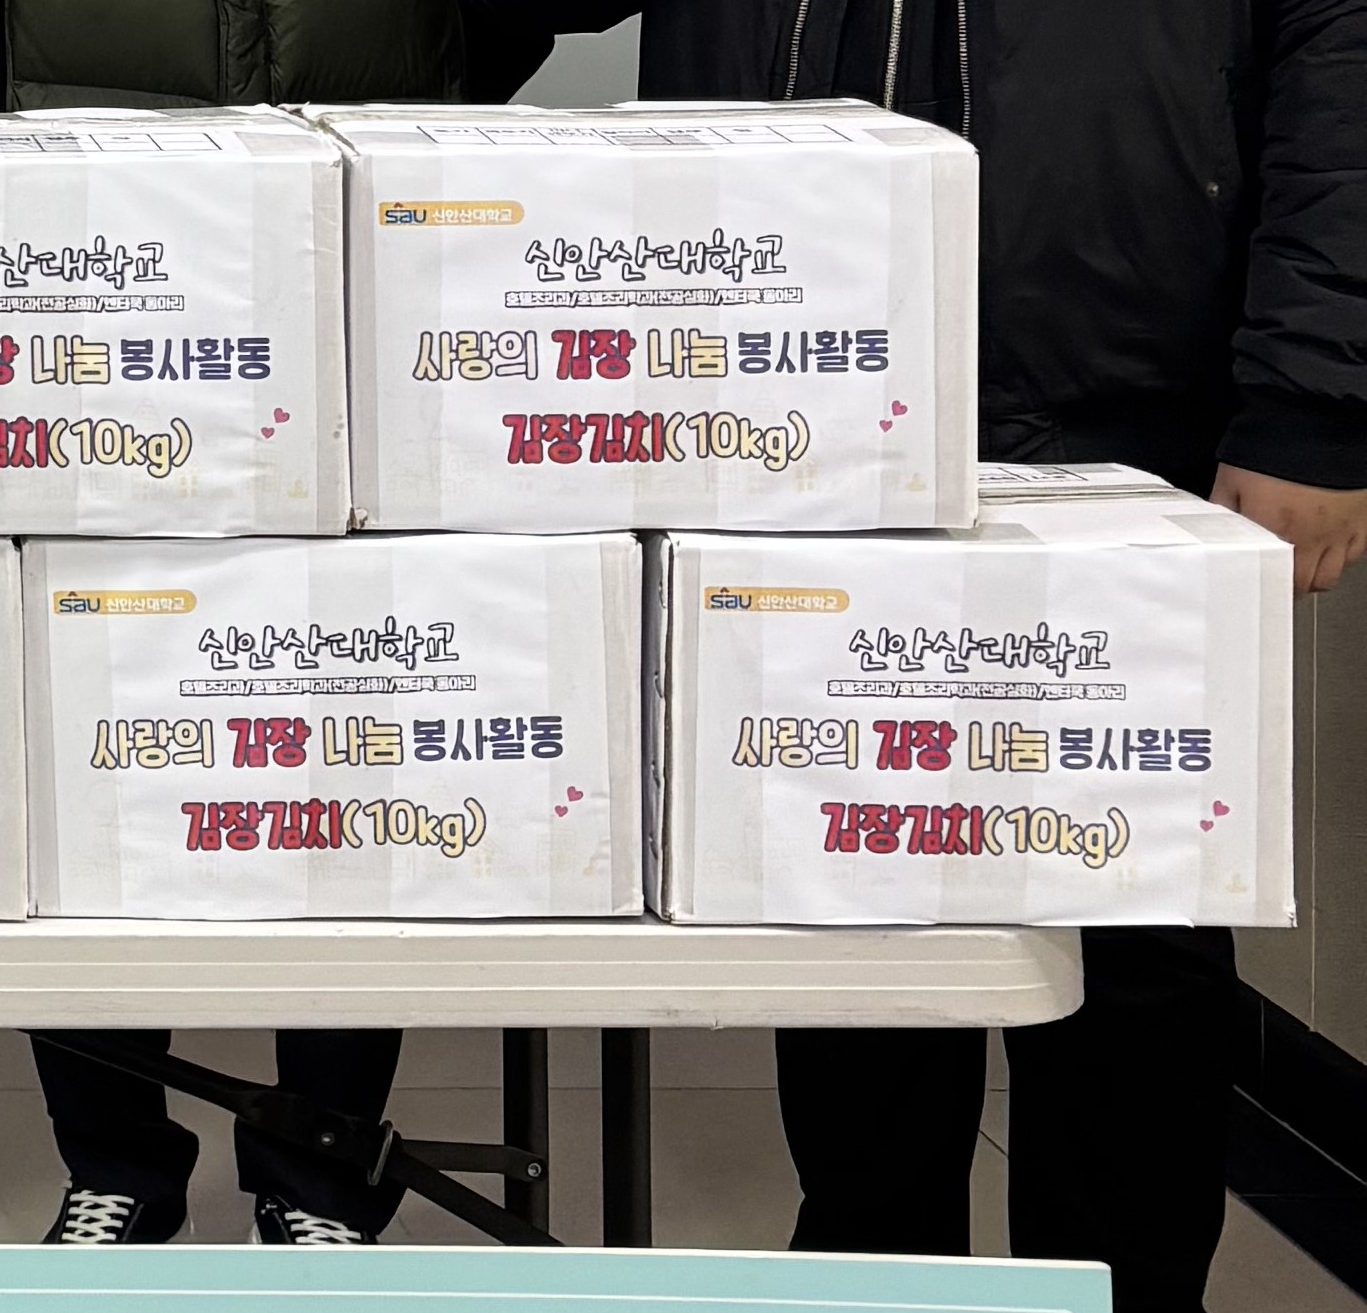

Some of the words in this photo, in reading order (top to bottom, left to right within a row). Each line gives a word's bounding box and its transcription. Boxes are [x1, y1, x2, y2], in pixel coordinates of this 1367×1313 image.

[503, 410, 811, 474] 김장김치(10kg)
[197, 616, 460, 672] 신안산대학교
[848, 620, 1112, 678] 신안산대학교
[182, 797, 488, 861] 김장김치(10kg)
[821, 801, 1130, 870] 김장김치(10kg)
